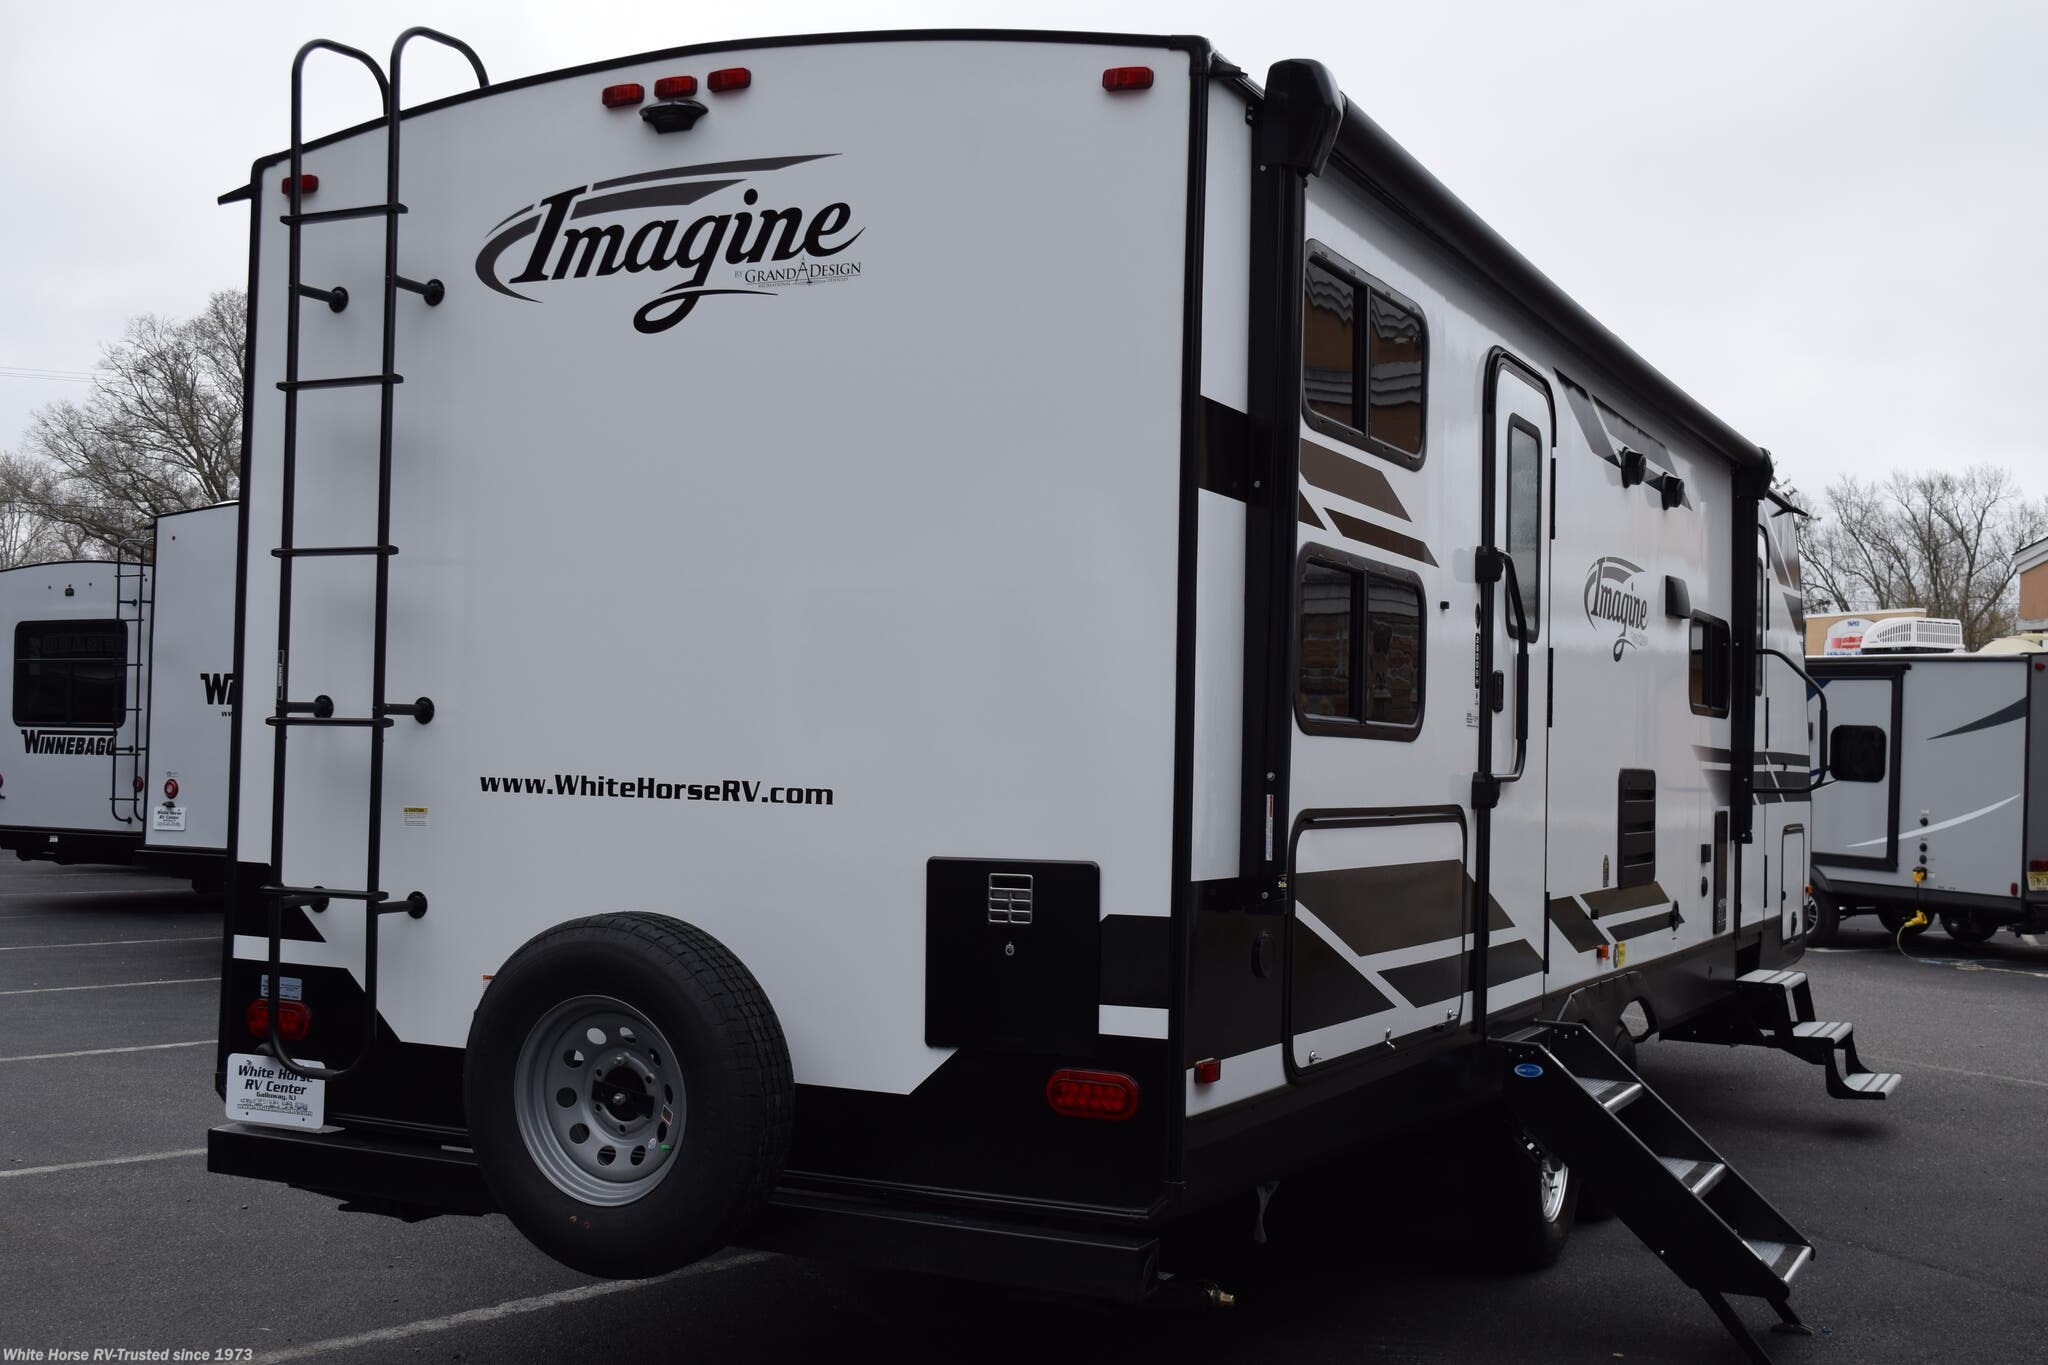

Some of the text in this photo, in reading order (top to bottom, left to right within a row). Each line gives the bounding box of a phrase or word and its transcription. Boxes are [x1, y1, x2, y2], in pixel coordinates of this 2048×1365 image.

[509, 185, 866, 334] Imagine
[744, 267, 797, 283] GRAND
[810, 262, 862, 278] DESIGN
[1590, 556, 1648, 662] Imagine
[21, 730, 117, 755] WINNEBAGO
[479, 773, 834, 806] www.WhiteHorseRV.com
[238, 1064, 275, 1079] White
[244, 1078, 308, 1095] RV Center
